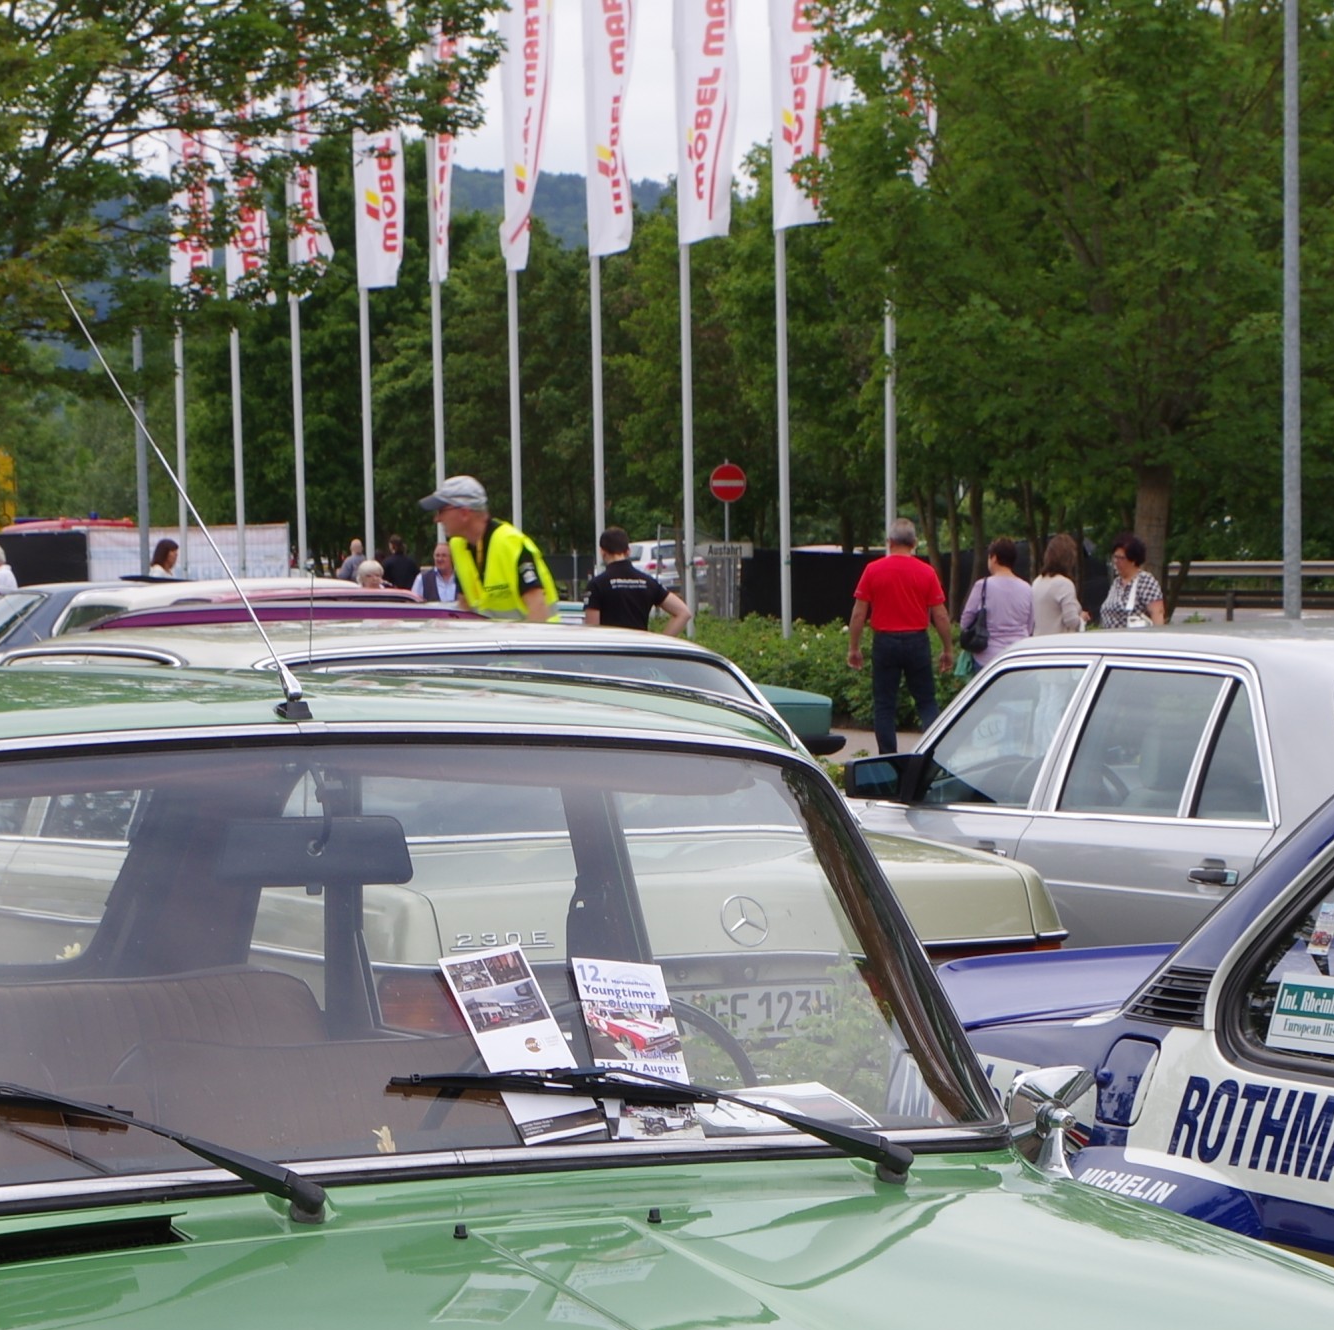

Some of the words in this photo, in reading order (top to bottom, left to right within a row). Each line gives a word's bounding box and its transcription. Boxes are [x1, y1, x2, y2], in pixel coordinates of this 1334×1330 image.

[583, 983, 656, 1000] Youngtimer
[1280, 988, 1299, 1011] Int.
[1283, 1018, 1322, 1038] European
[643, 1063, 681, 1075] August
[1077, 1167, 1179, 1205] MICHELIN
